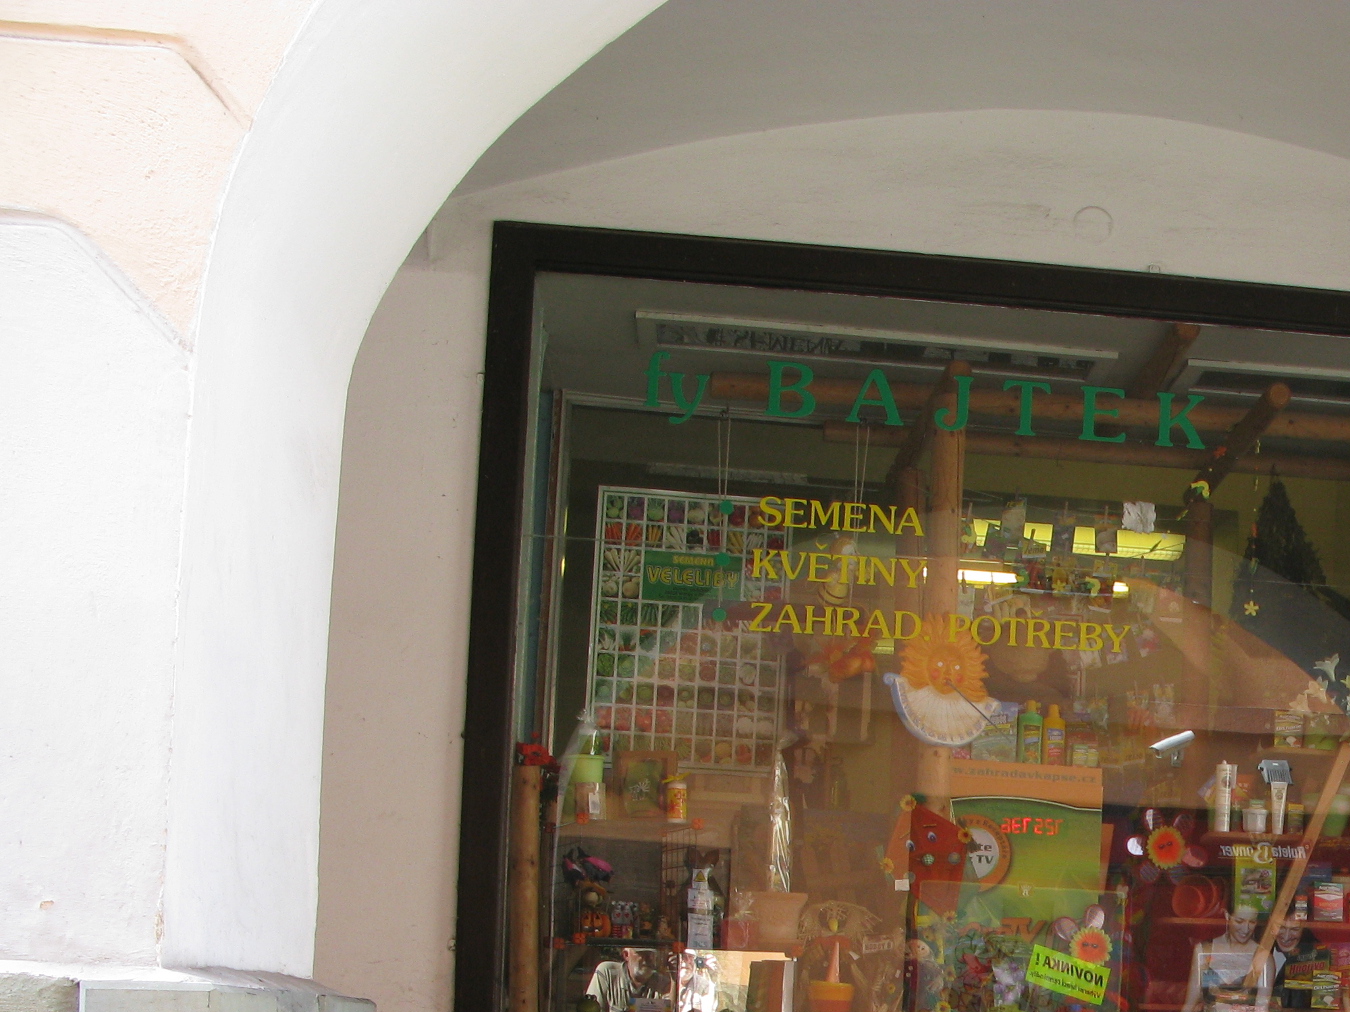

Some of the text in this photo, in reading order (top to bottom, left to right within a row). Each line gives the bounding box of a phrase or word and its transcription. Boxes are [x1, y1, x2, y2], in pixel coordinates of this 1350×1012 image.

[765, 359, 1207, 450] BAJTEK
[757, 495, 925, 537] SEMENA
[751, 544, 926, 589] KVĚTINY
[748, 601, 1132, 654] ZAHRAD. POTŘEBY
[976, 854, 994, 865] TV
